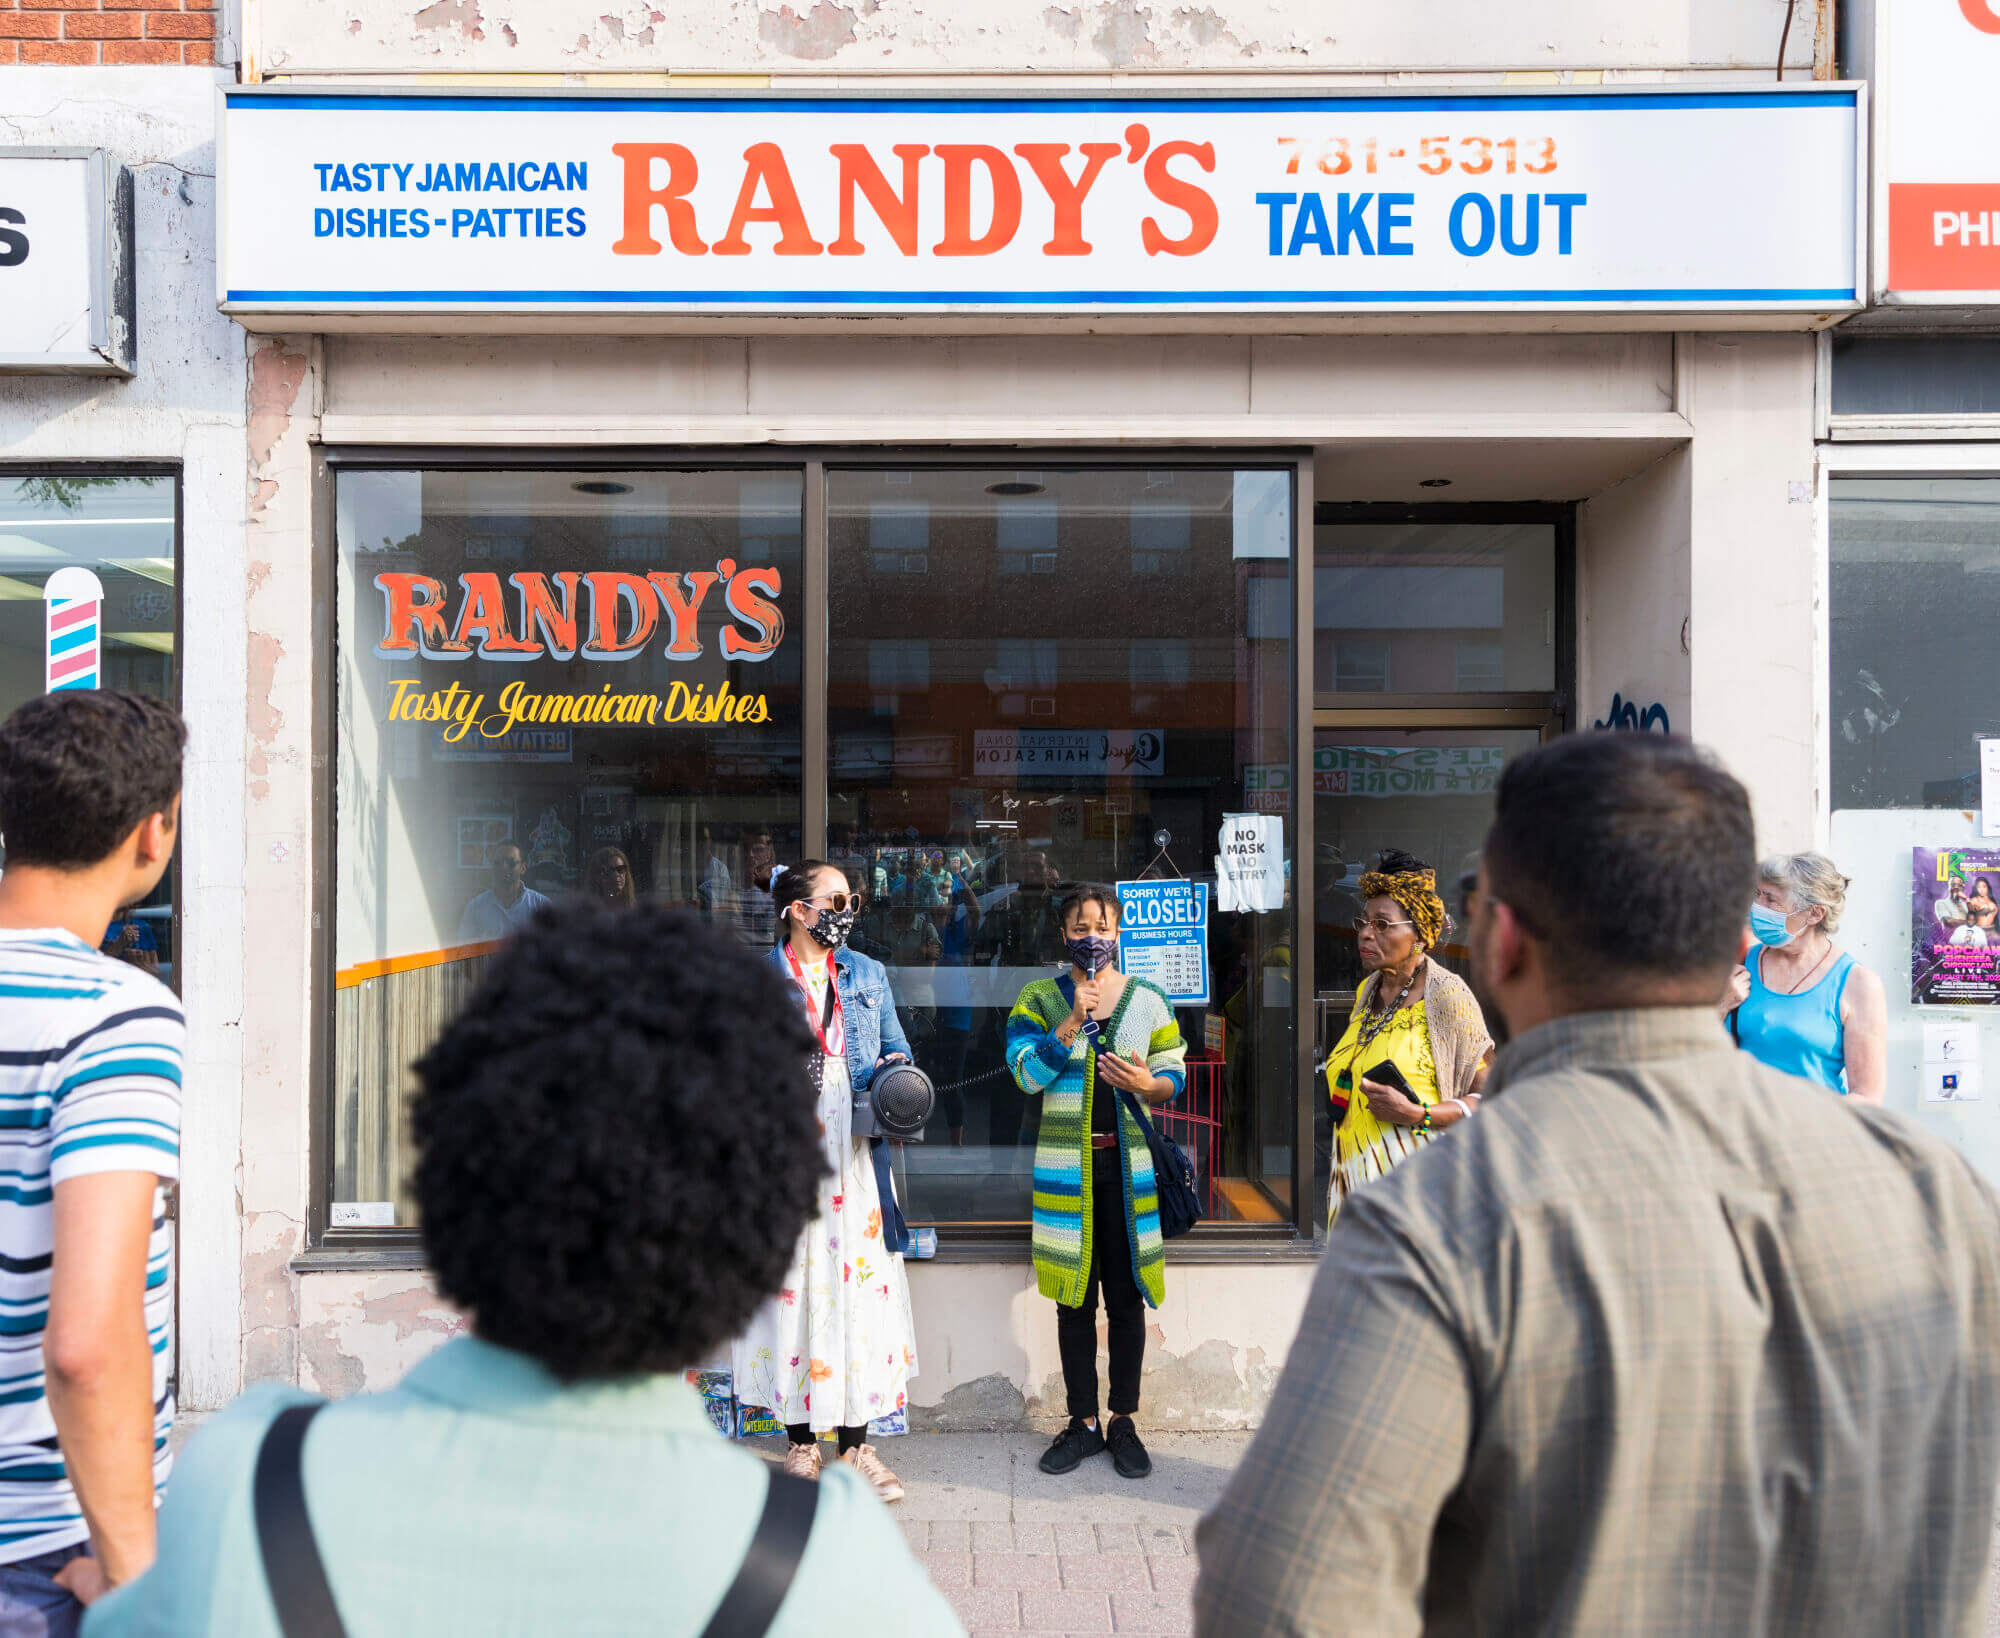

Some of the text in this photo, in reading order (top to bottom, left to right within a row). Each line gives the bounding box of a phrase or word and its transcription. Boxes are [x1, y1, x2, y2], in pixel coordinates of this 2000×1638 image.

[313, 161, 588, 192] TASTY JAMAICAN
[612, 123, 1219, 257] RANDY'S
[1255, 192, 1587, 257] TAKE OUT
[373, 558, 785, 662] RANDY'S
[388, 679, 485, 742] Tasty
[479, 680, 658, 738] Jamaican
[1227, 843, 1265, 855] MASK
[1235, 830, 1256, 841] NO
[1228, 869, 1267, 880] ENTRY
[1123, 887, 1201, 899] SORRY WE'RE
[1123, 898, 1202, 925] CLOSED
[1132, 930, 1192, 940] BUSINESS HOURS
